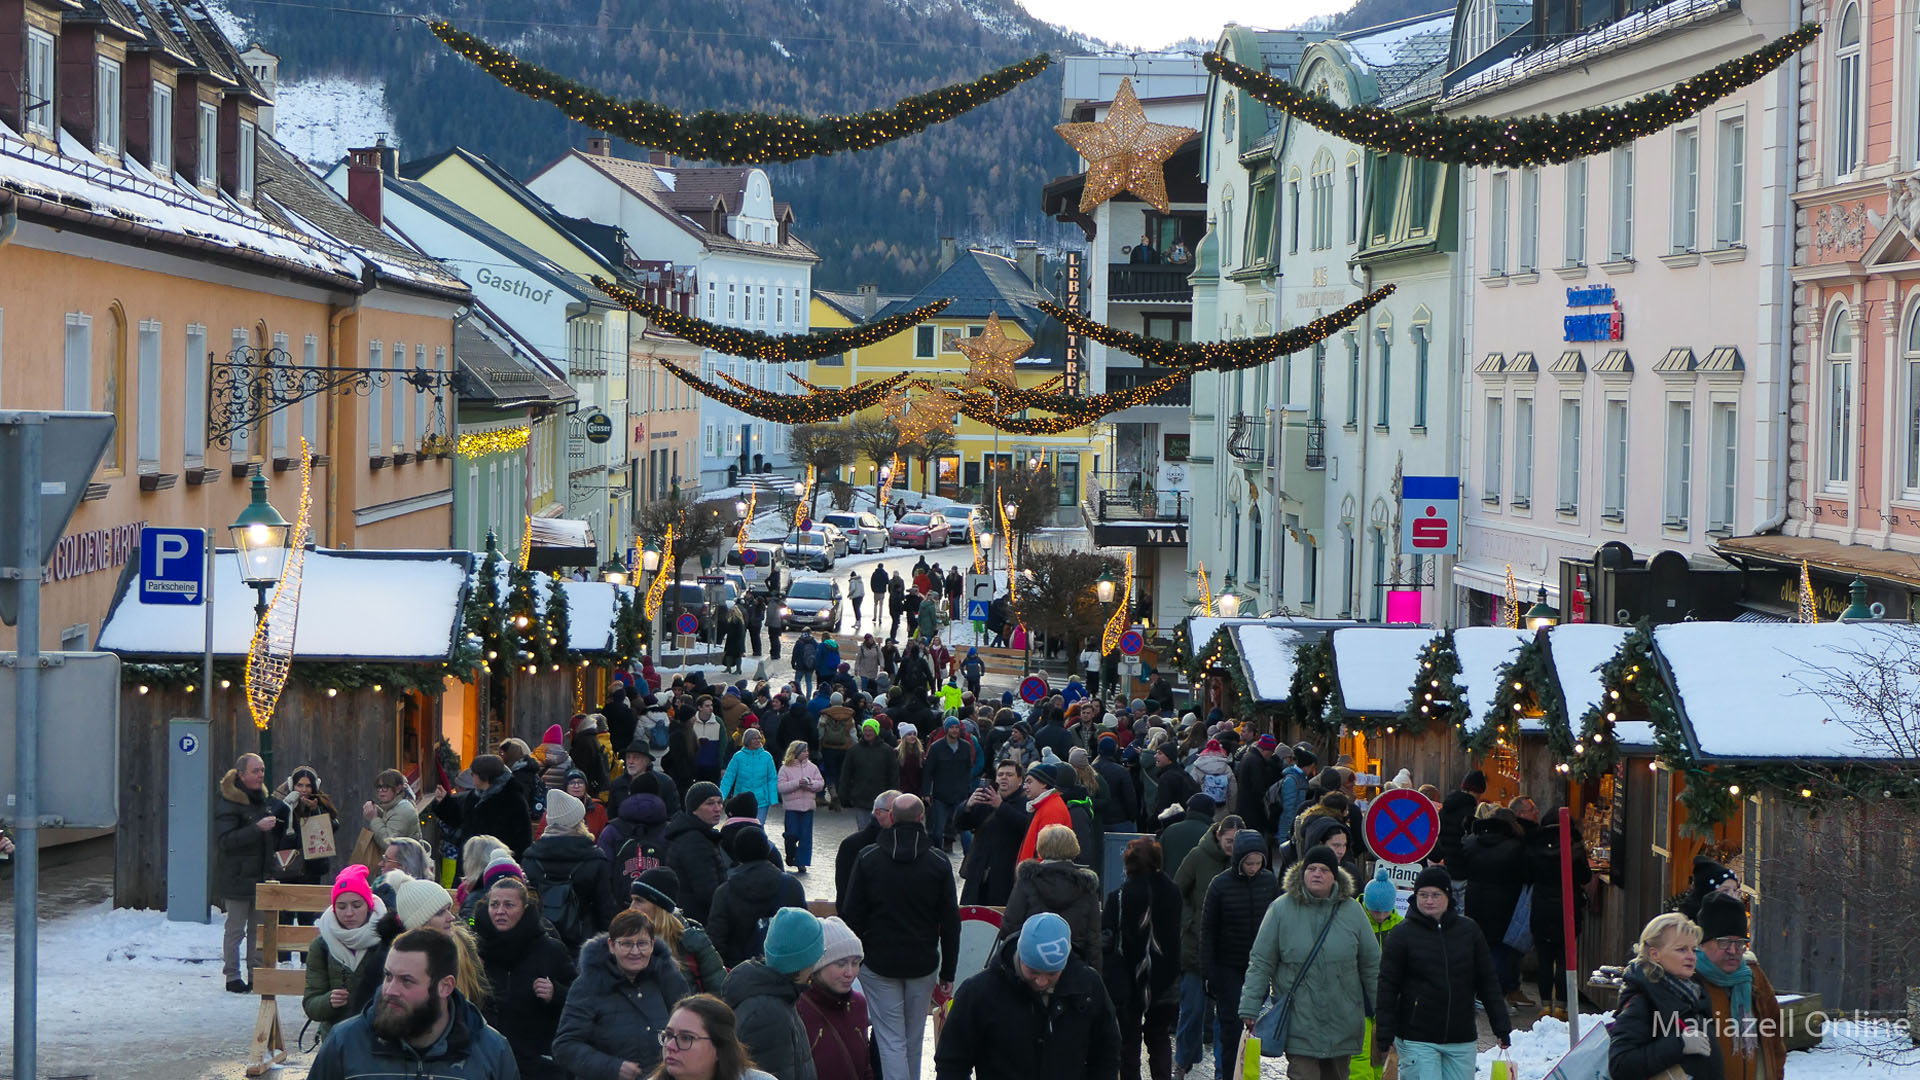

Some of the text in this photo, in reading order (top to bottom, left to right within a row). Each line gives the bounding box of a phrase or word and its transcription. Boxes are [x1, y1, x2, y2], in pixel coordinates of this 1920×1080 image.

[476, 267, 554, 305] Gasthof
[1147, 528, 1189, 543] MA
[54, 519, 149, 582] GOLDENE KRON
[155, 533, 189, 577] P
[148, 581, 195, 592] Parkscheine
[1379, 864, 1418, 885] nfang
